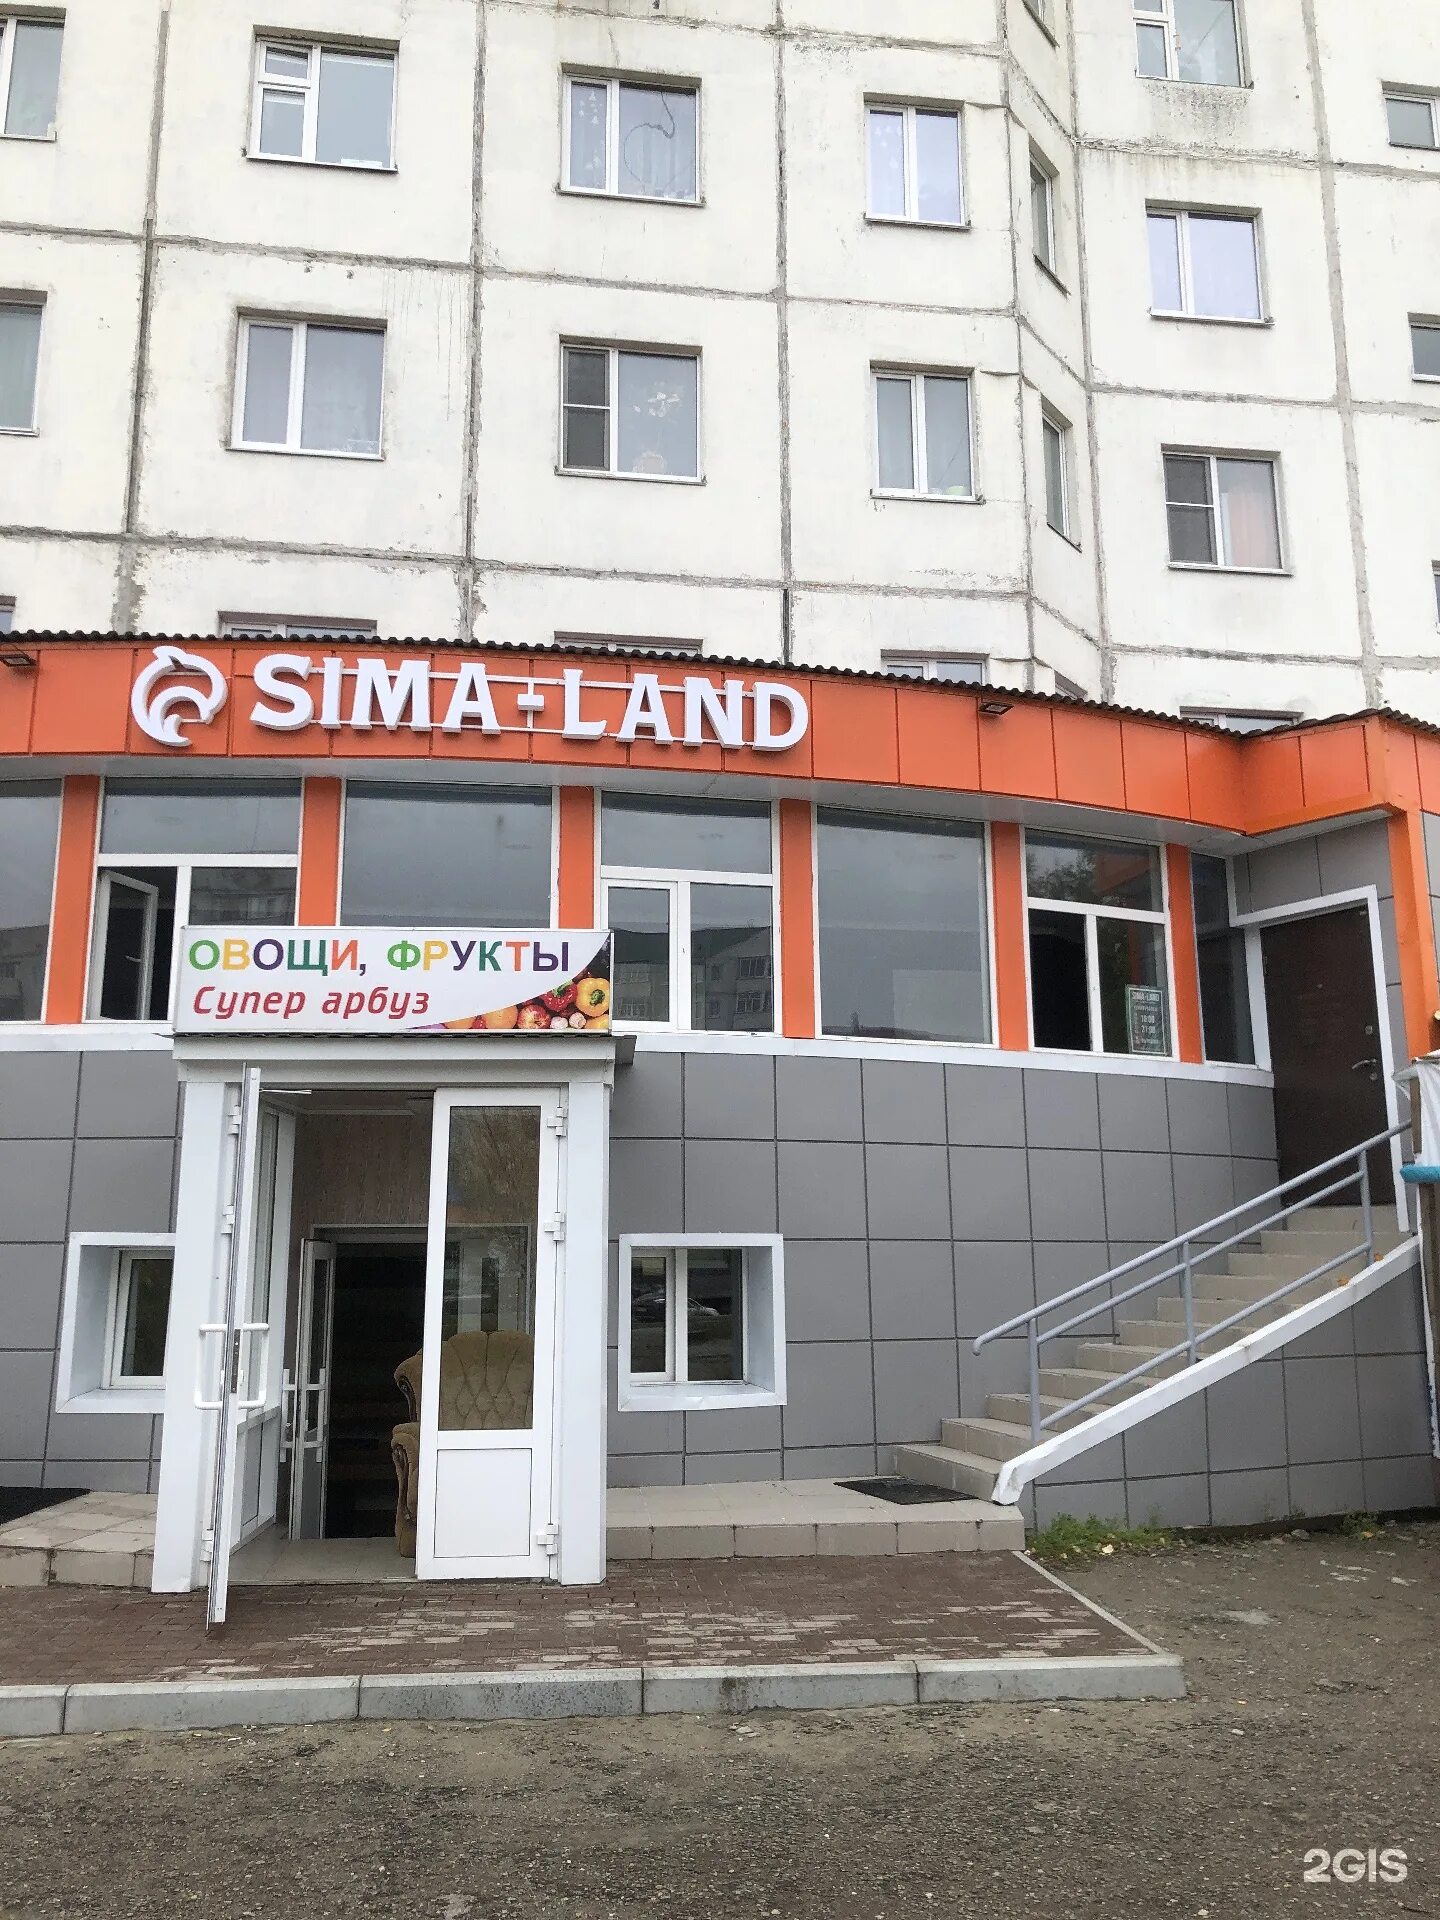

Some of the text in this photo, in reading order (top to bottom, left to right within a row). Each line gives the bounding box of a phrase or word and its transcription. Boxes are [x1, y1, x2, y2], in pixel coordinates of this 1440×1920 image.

[250, 653, 809, 752] SIMA-LAND
[188, 938, 570, 977] ОВОЩИ, ФРУКТЫ
[192, 986, 430, 1020] Супер арбуз
